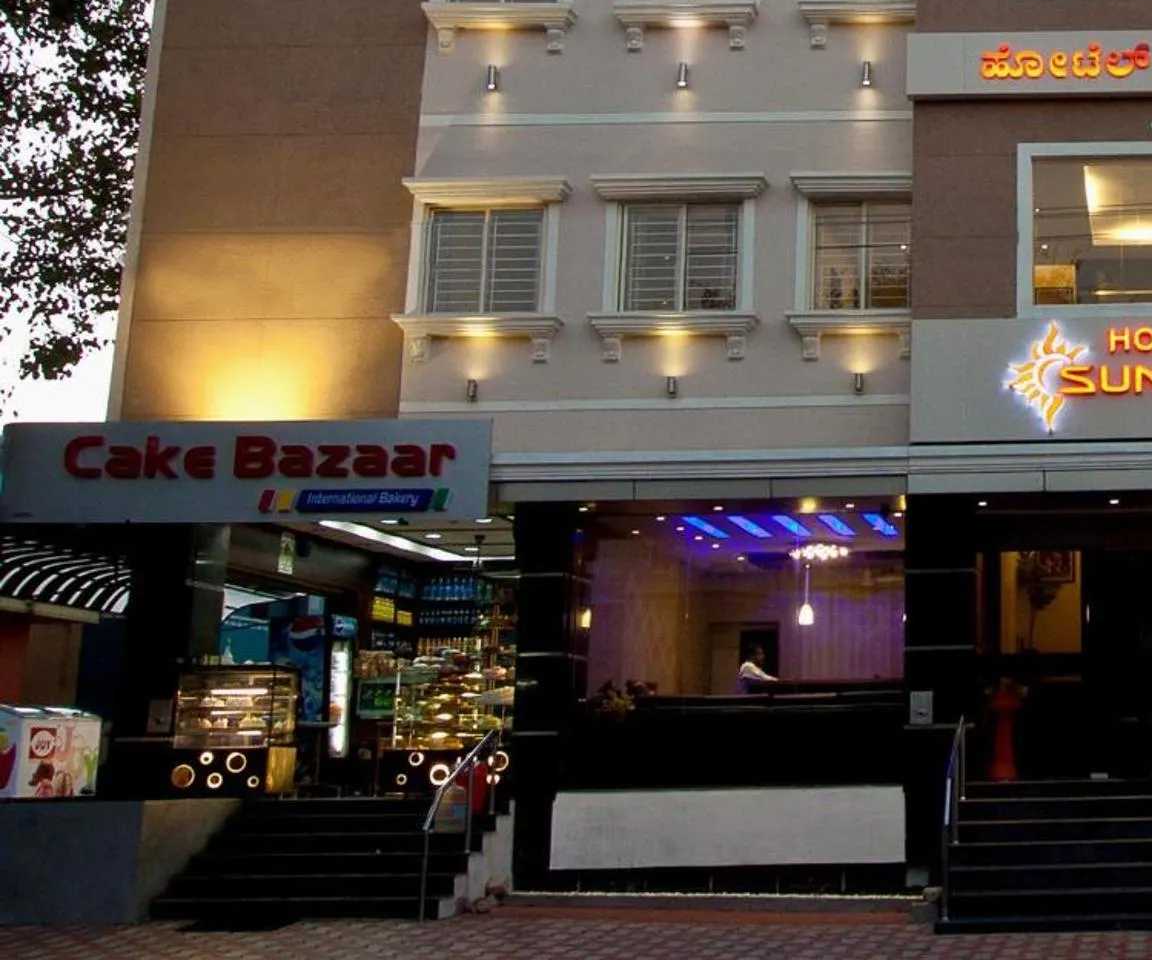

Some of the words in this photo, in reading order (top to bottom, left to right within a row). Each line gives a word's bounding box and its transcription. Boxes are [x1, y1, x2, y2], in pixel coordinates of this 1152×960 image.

[982, 41, 1151, 80] ಹೋಟೆಲ್
[63, 435, 217, 480] Cake
[233, 435, 457, 479] Bazaar
[306, 492, 378, 505] International
[378, 491, 421, 507] Bakery
